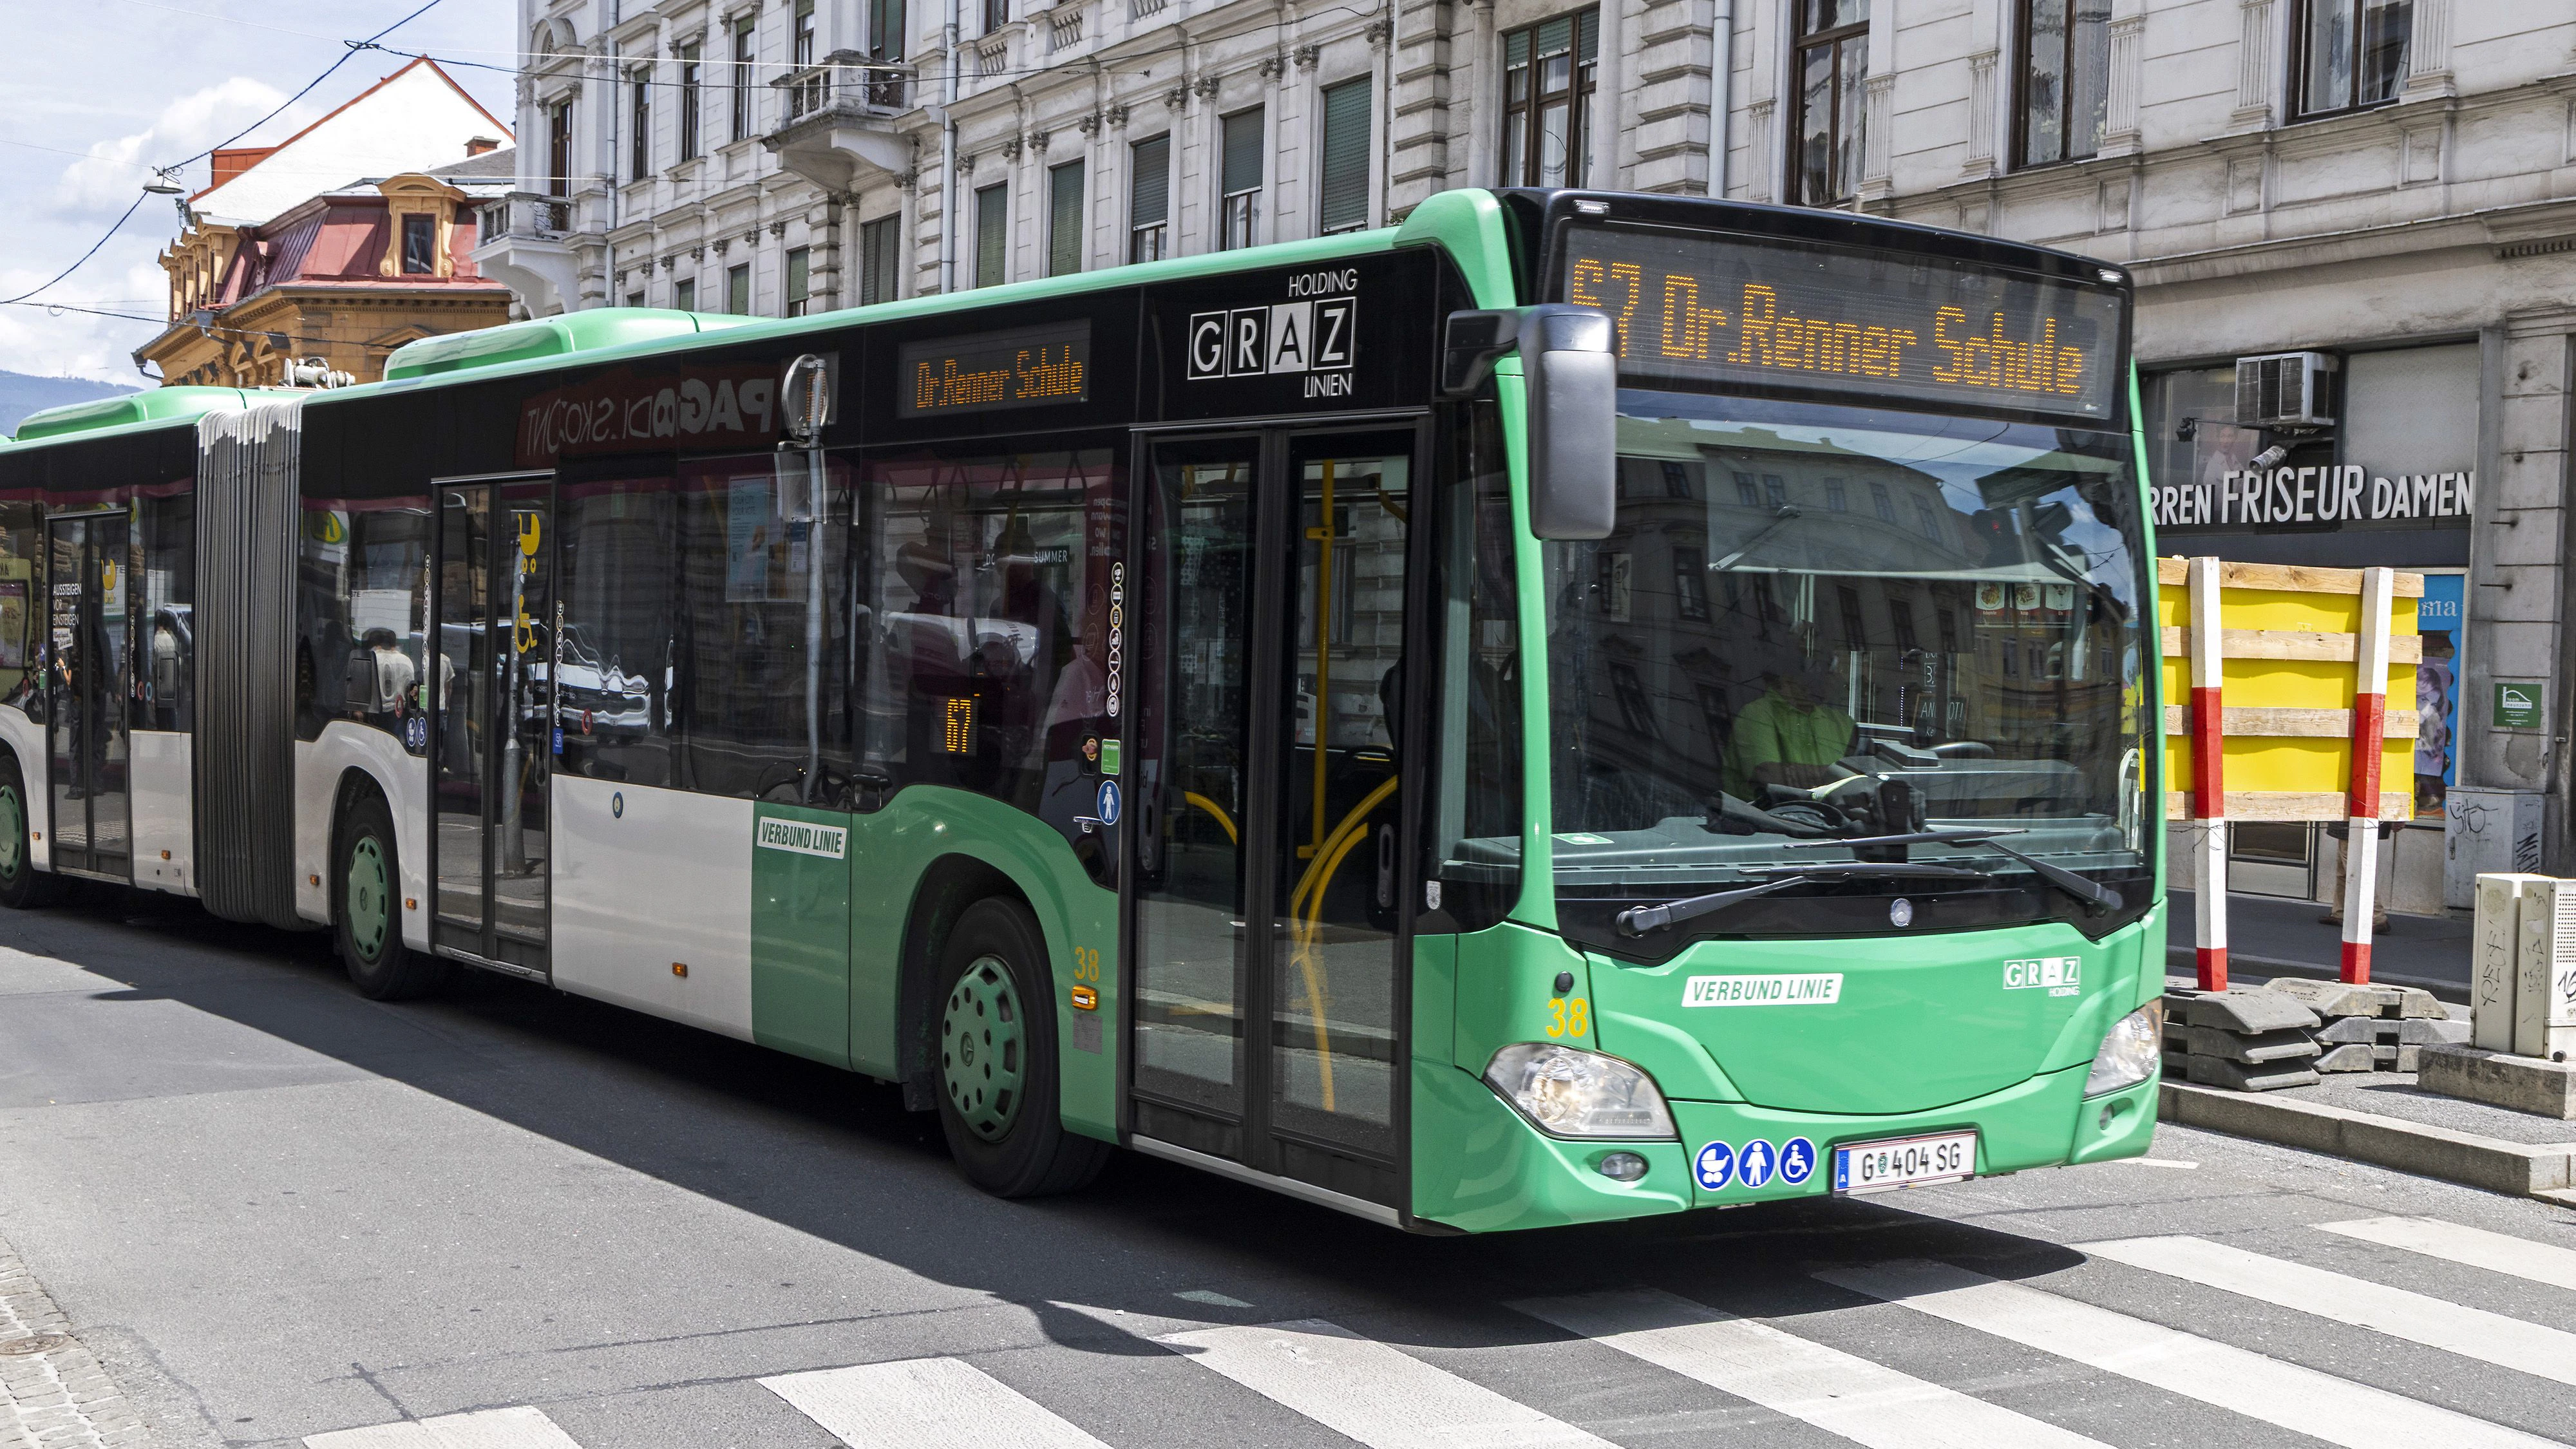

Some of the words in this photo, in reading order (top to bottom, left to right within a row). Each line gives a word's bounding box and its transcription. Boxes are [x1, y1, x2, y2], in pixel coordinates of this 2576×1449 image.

[1289, 268, 1358, 298] HOLDING
[1192, 306, 1349, 373] GRAZ
[1662, 274, 1917, 378] Dr.Renner
[1932, 305, 2084, 395] Schule
[916, 358, 1010, 408] Dr.Renner
[1016, 345, 1083, 399] Schule
[1304, 373, 1353, 398] LINIEN
[2222, 465, 2364, 524] FRISEUR
[2371, 471, 2475, 520] DAMEN
[1034, 549, 1068, 564] SUMMER
[53, 583, 82, 596] AUSSTEIGEN
[53, 614, 79, 626] EINSTEIGEN
[2418, 599, 2458, 617] ma
[946, 698, 971, 753] 67
[762, 821, 810, 849] VERBUND
[812, 829, 843, 853] LINIE
[1074, 945, 1100, 983] 38
[2005, 959, 2078, 987] GRAZ
[1694, 980, 1783, 1001] VERBUND
[1786, 979, 1834, 999] LINIE
[1546, 997, 1588, 1039] 38
[1891, 1146, 1930, 1178] 404
[1935, 1141, 1961, 1172] SG
[1839, 1173, 1847, 1184] A
